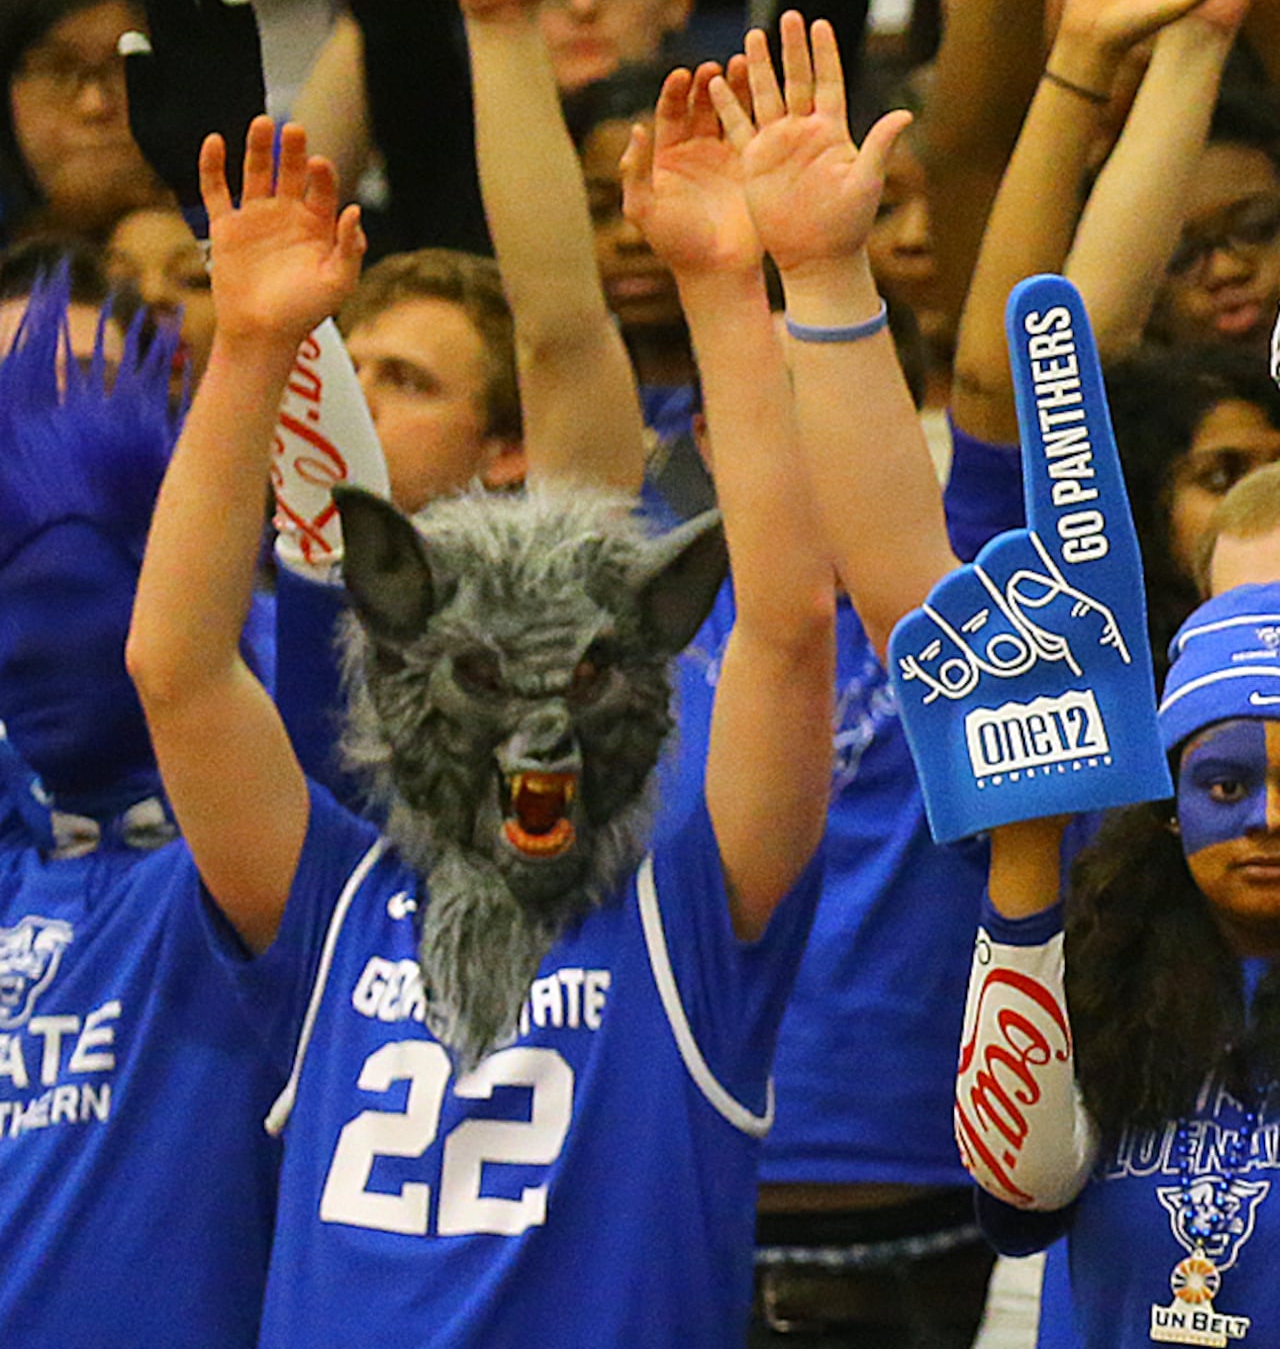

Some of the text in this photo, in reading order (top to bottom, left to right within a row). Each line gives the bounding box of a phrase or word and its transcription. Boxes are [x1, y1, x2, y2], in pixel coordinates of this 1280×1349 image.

[1024, 306, 1109, 565] GO PANTHERS
[320, 1039, 574, 1237] 22
